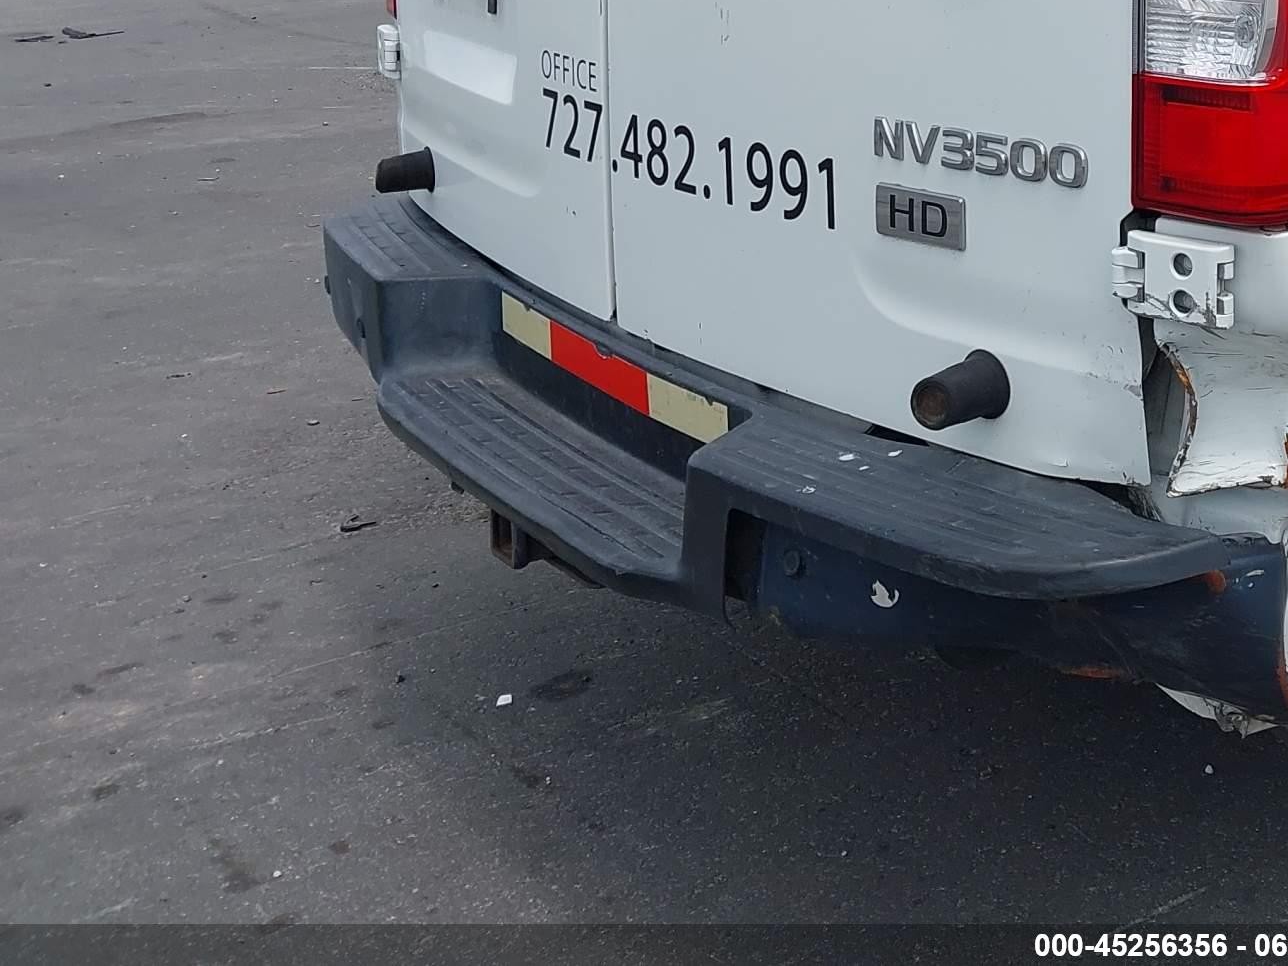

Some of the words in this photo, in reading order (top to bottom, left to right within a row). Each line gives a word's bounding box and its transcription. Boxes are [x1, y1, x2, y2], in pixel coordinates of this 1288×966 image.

[541, 49, 597, 93] OFFICE
[542, 88, 836, 230] 727.482.1991
[873, 116, 1089, 190] NV3500
[889, 194, 948, 239] HD
